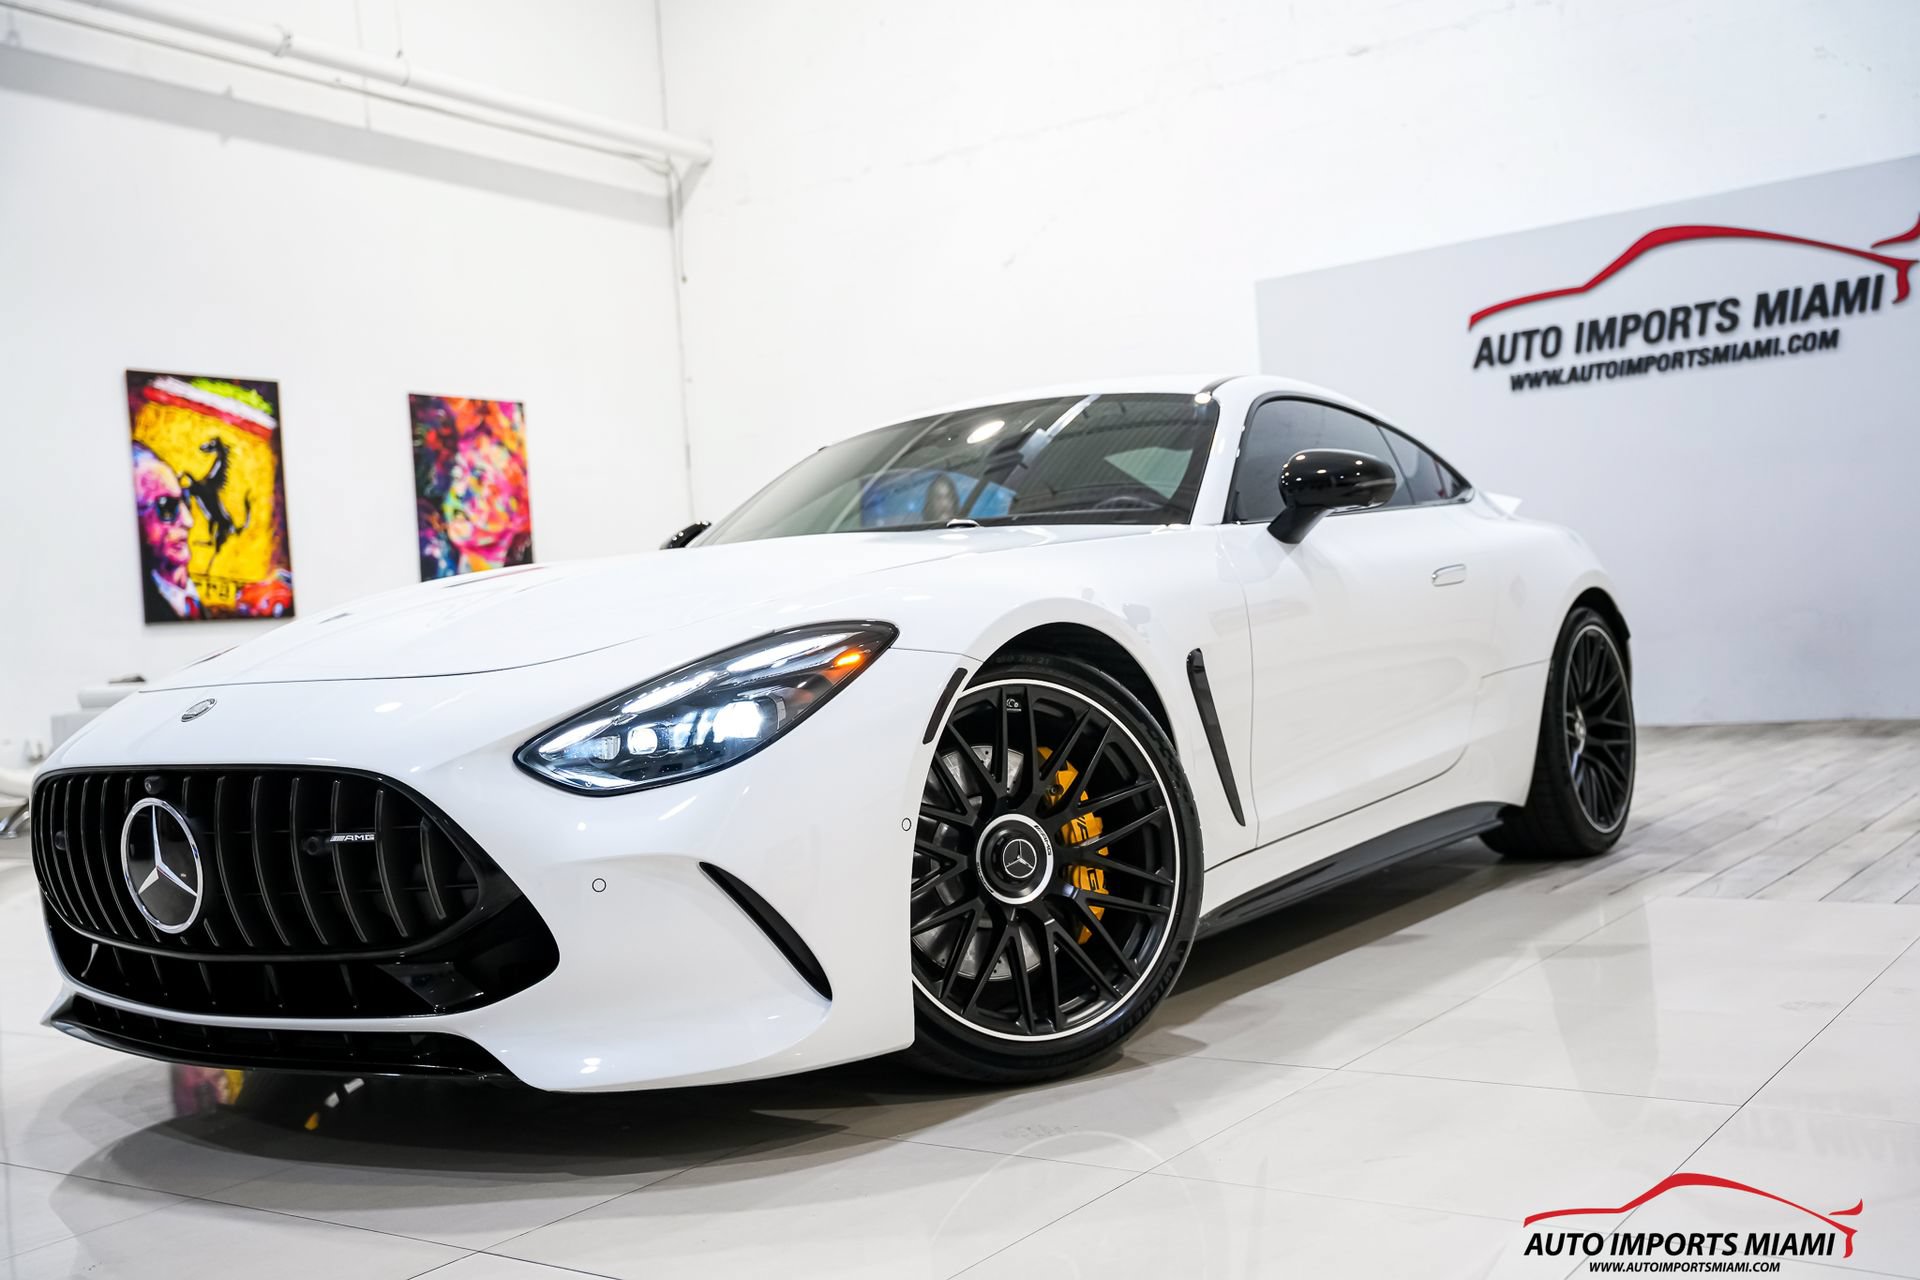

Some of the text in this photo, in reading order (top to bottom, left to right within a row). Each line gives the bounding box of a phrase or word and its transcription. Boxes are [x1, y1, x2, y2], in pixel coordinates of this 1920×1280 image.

[1473, 273, 1885, 369] AUTO IMPORTS MIAMI
[1510, 328, 1840, 391] WWW.AUTOIMPORTSMIAMI.COM
